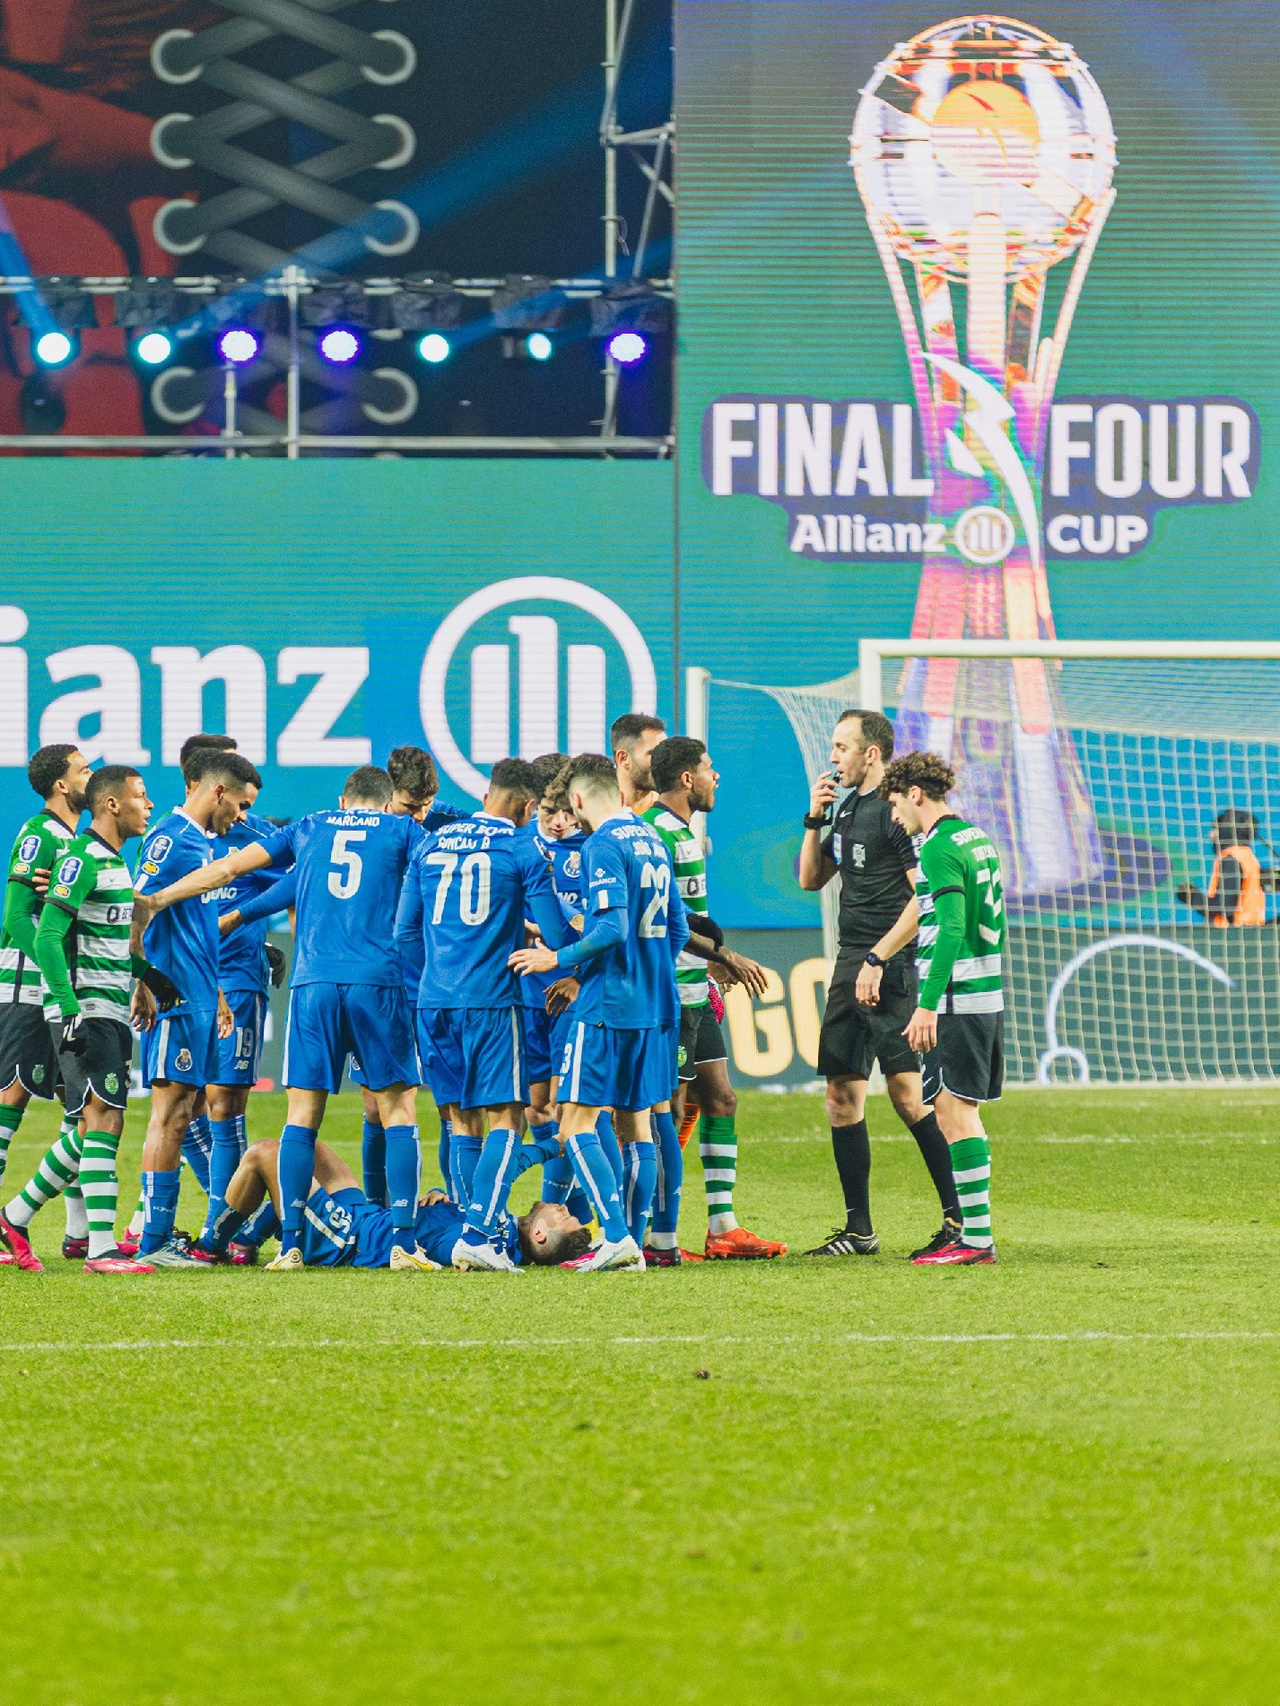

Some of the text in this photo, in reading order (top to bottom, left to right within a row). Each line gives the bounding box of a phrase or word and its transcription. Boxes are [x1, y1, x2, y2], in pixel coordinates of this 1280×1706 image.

[711, 402, 1252, 499] FINAL FOUR
[790, 513, 1149, 554] Allianz CUP
[326, 815, 380, 827] MARCANO
[435, 823, 477, 836] SUPER
[327, 830, 367, 900] 5
[425, 851, 492, 926] 70
[235, 1026, 254, 1058] 19
